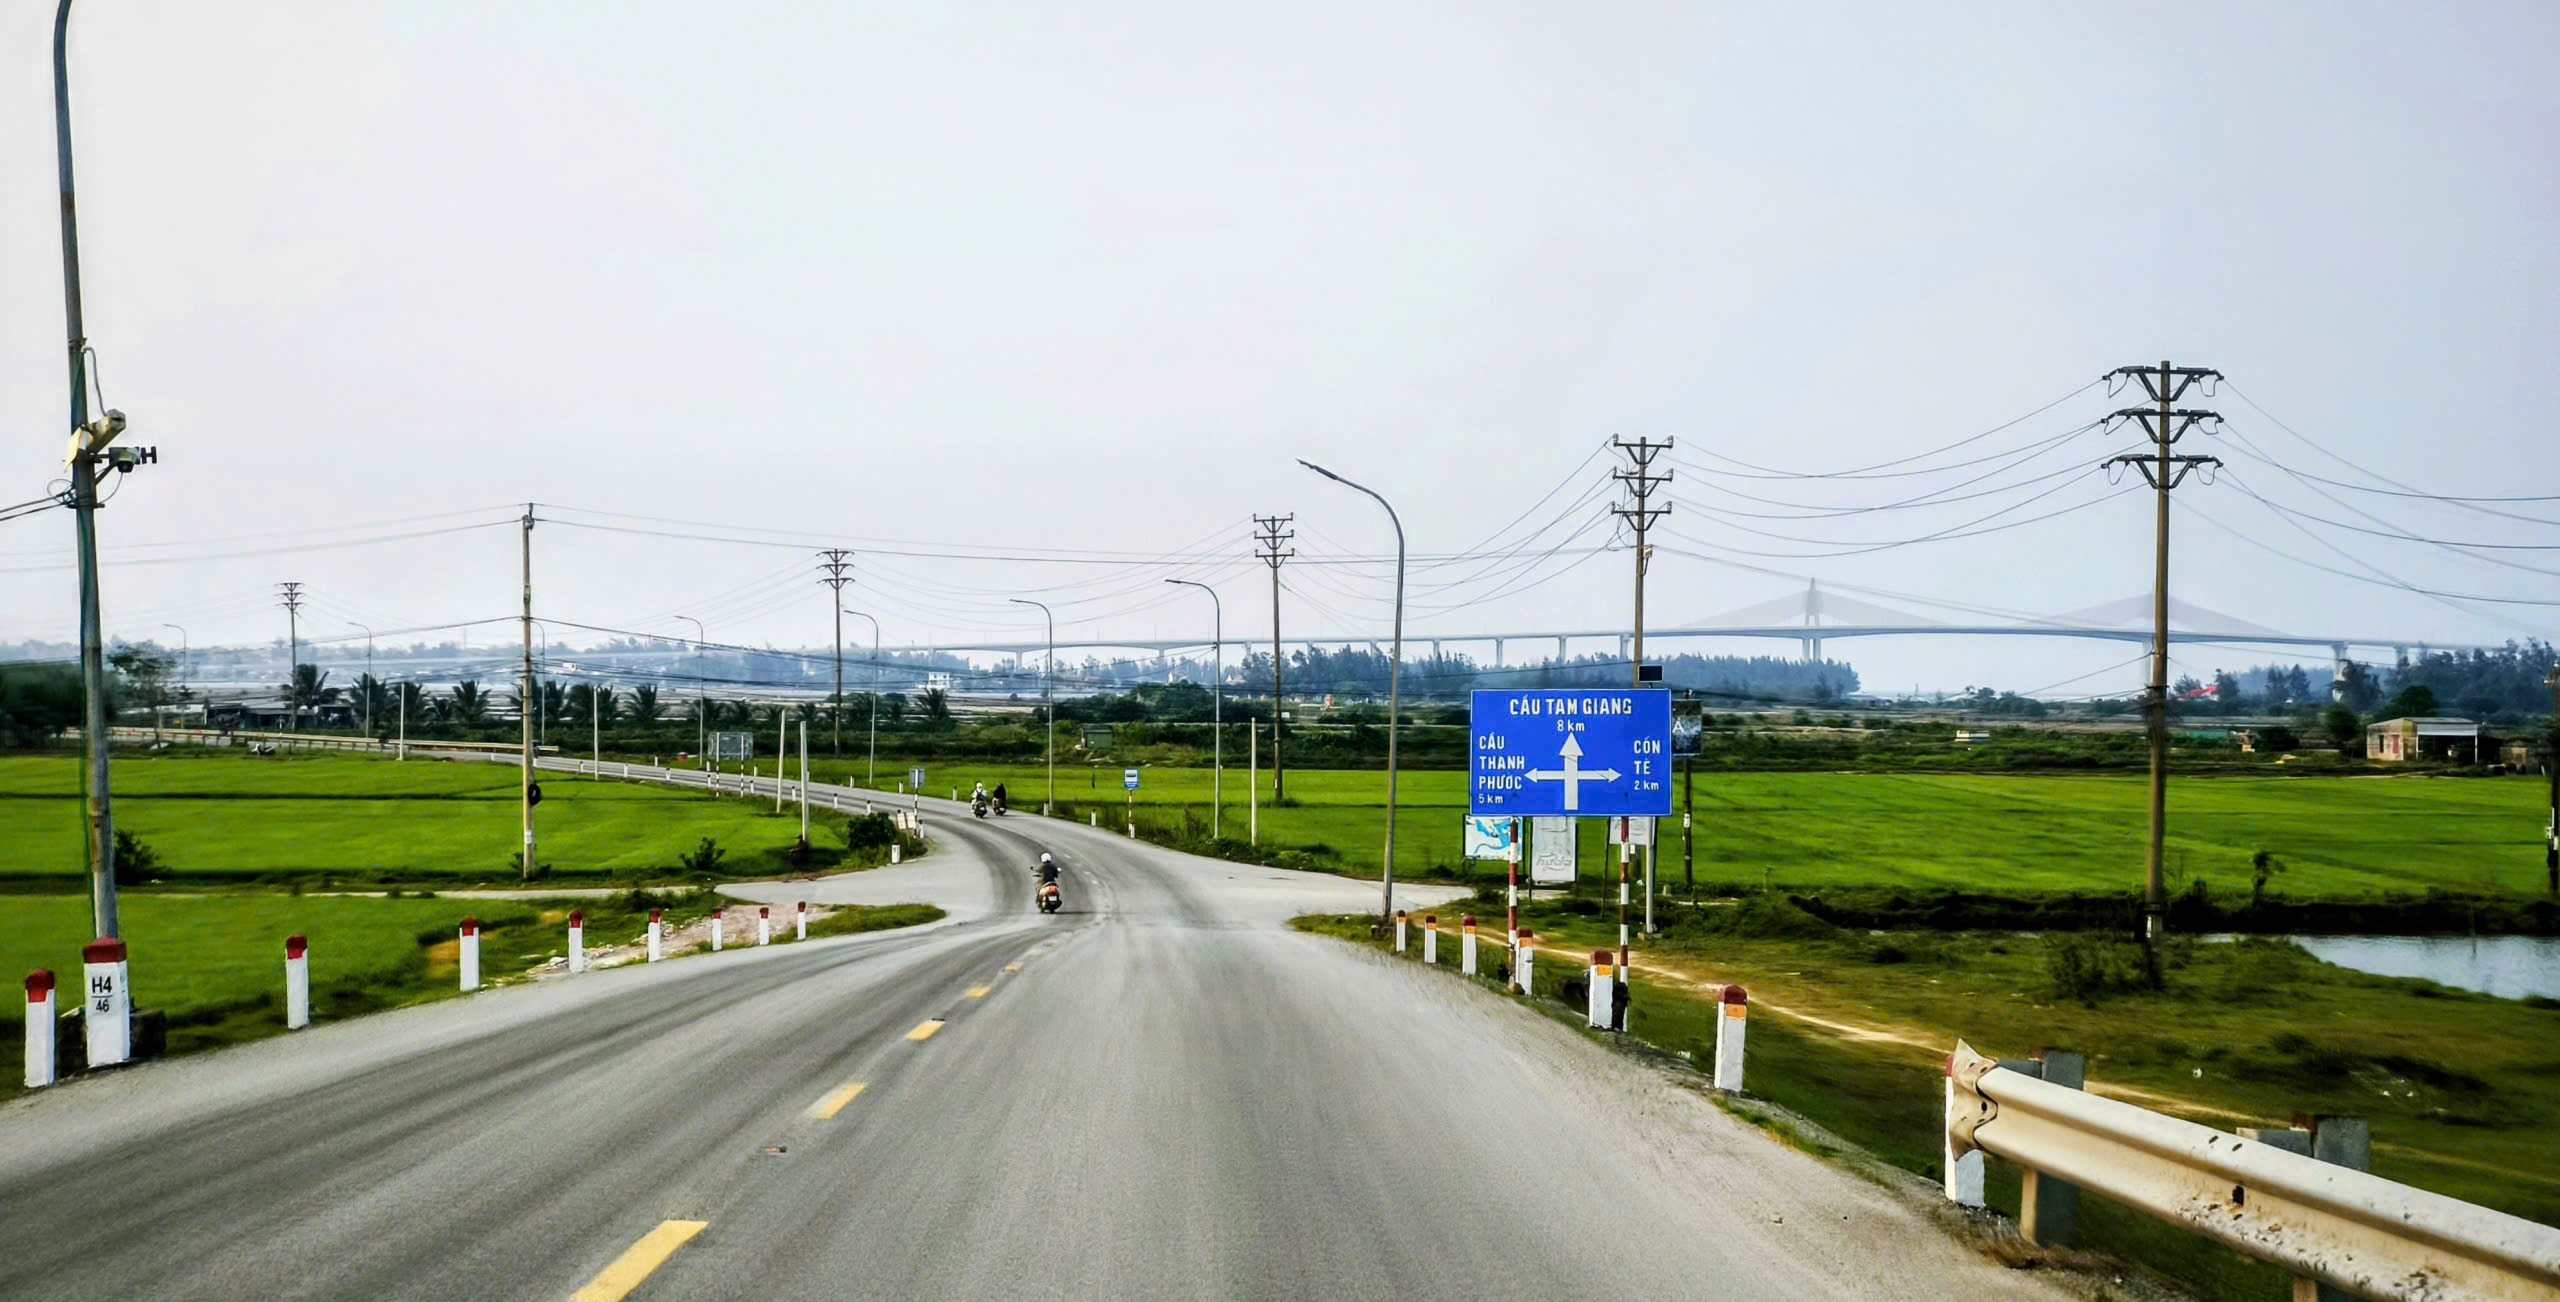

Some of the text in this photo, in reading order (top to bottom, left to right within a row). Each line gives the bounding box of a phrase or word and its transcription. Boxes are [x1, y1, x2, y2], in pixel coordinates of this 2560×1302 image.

[1545, 698, 1578, 715] TAM
[1582, 698, 1632, 715] GIANG
[1557, 719, 1585, 732] 8 km
[1479, 755, 1525, 770] THANH
[1634, 780, 1660, 791] 2 km
[1478, 793, 1504, 804] 5 km
[92, 976, 112, 993] H4
[96, 999, 109, 1012] 46
